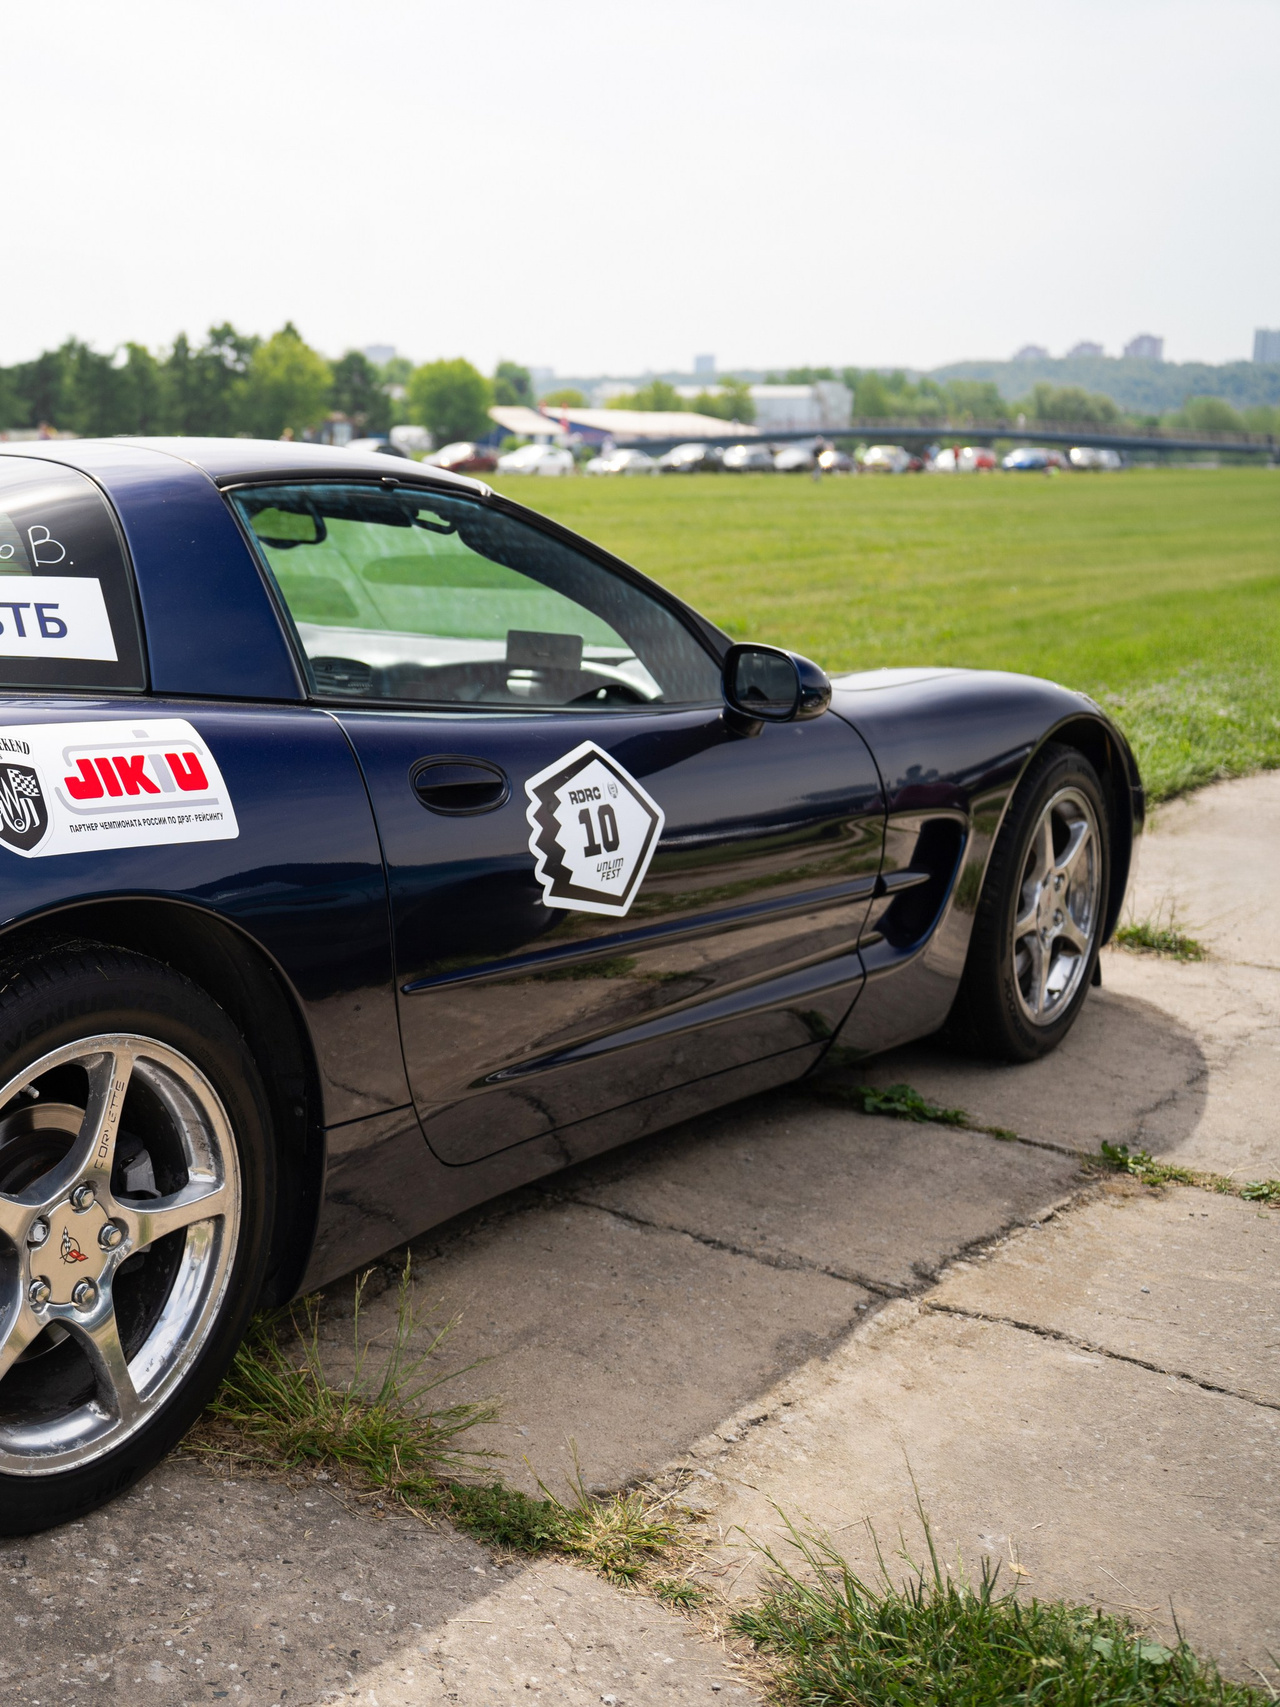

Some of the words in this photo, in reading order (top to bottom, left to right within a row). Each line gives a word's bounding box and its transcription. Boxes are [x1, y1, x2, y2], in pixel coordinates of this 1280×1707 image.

[568, 786, 601, 805] RDRC
[69, 823, 99, 833] ПАРТНЕР
[99, 819, 142, 830] ЧЕМПИОНАТА
[142, 817, 168, 826] РОССИИ
[167, 816, 177, 824] ПО
[194, 812, 224, 822] РЕЙСИНГУ
[578, 804, 620, 858] 10
[601, 868, 621, 881] FEST
[93, 1080, 125, 1170] CORVETTE
